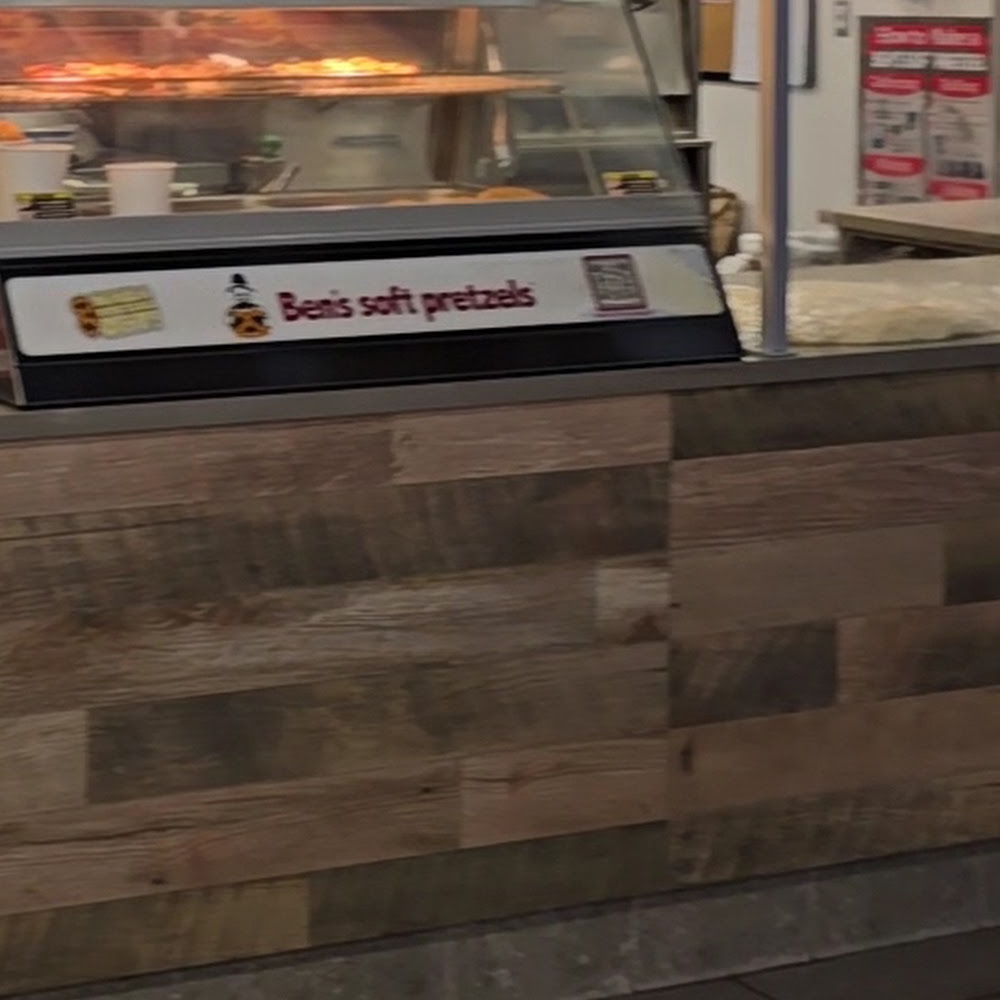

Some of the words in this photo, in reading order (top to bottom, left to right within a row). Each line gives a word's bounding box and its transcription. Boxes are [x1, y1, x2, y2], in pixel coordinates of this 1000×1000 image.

[278, 289, 354, 321] Ben's
[359, 286, 417, 316] soft
[420, 280, 536, 322] pretzels
